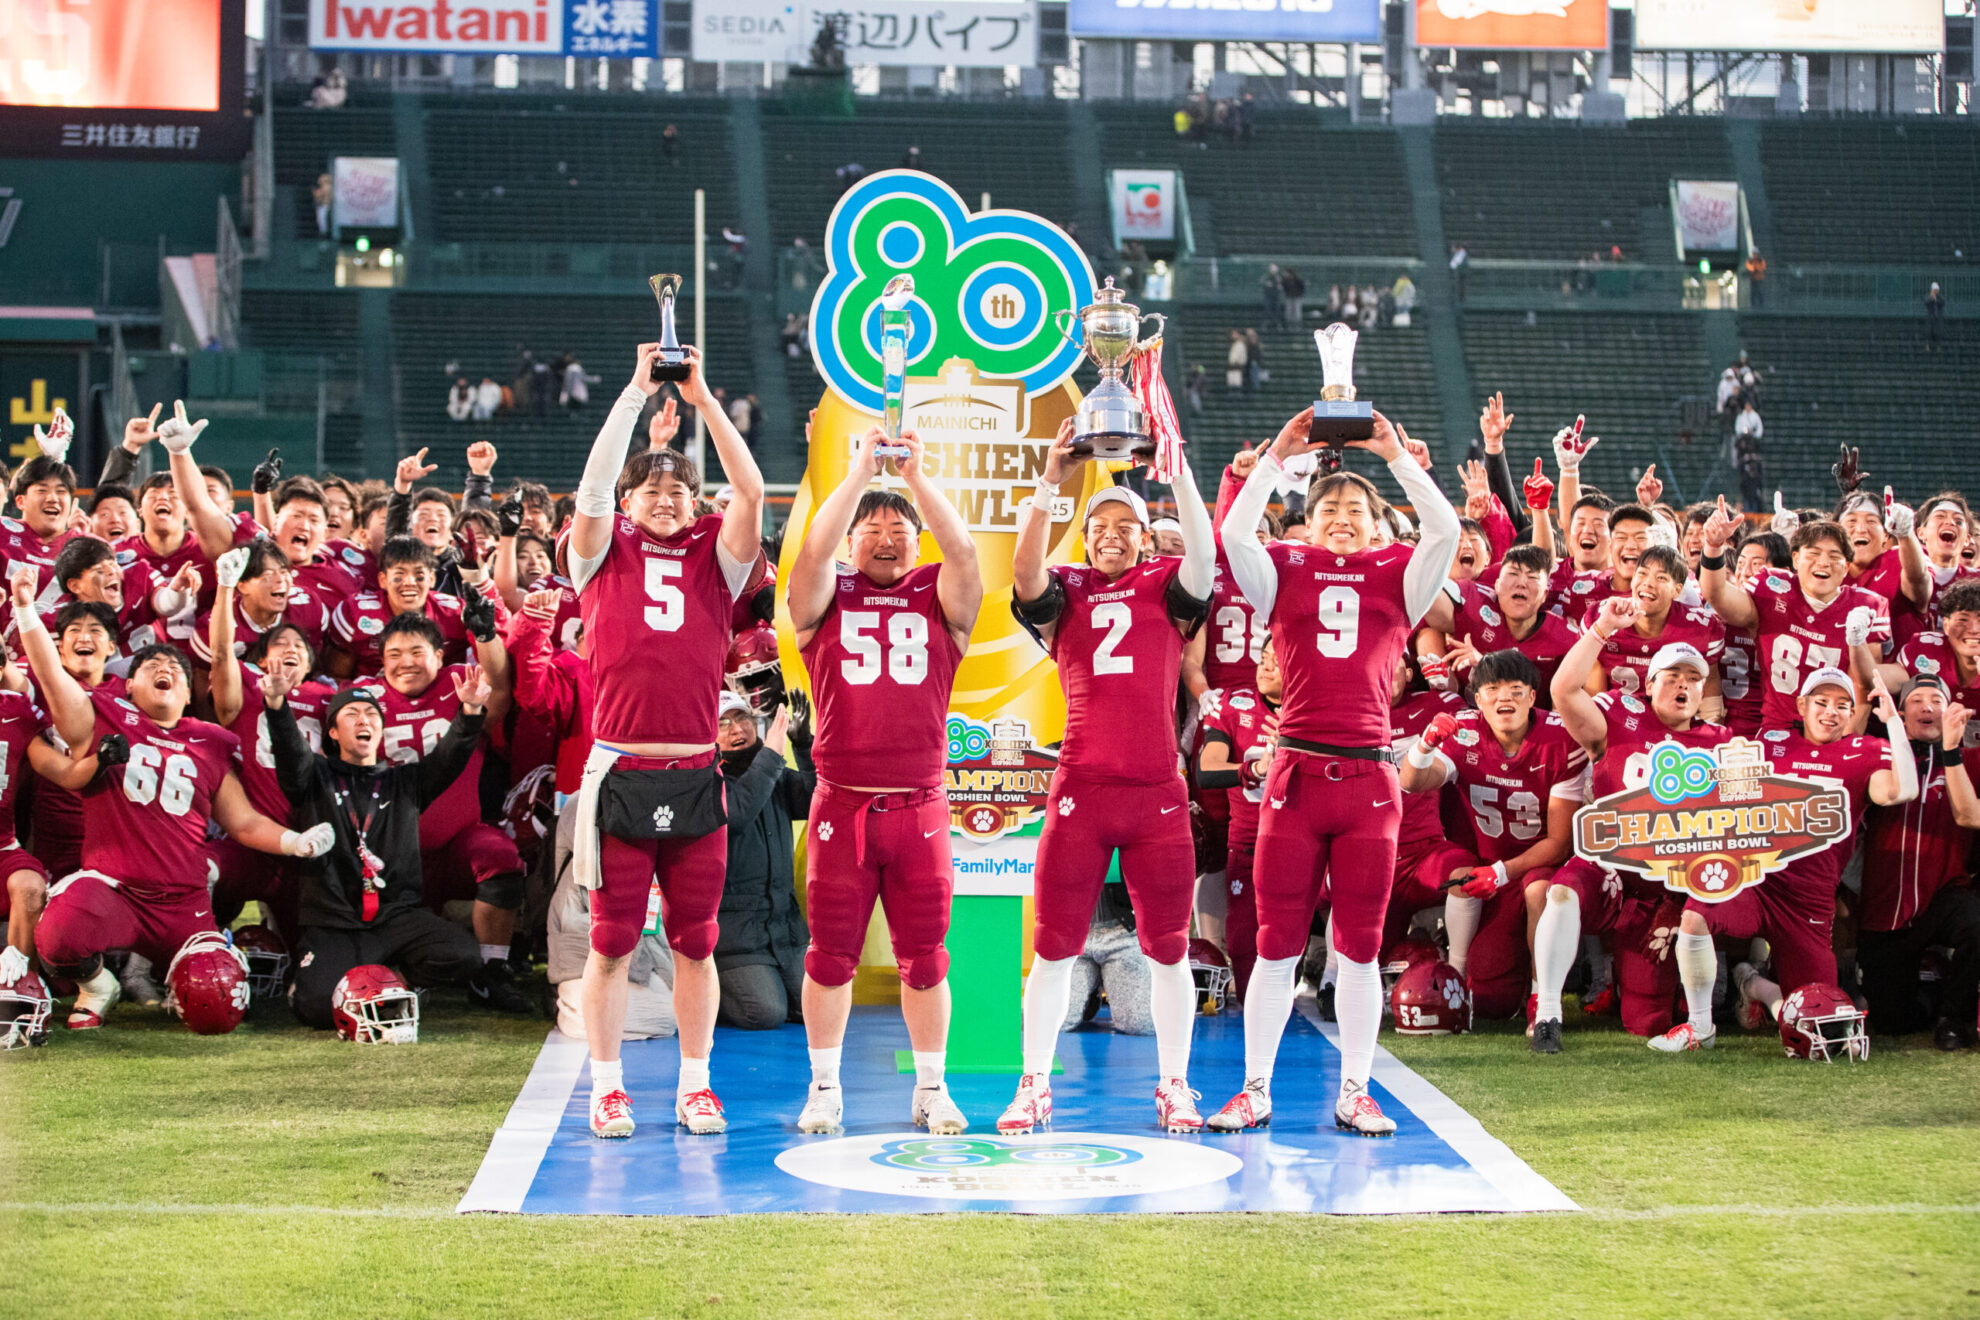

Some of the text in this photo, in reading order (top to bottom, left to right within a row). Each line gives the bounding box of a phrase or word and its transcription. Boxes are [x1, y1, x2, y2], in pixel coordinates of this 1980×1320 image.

[324, 0, 547, 42] Iwatani
[572, 0, 648, 34] 水素
[703, 16, 785, 34] SEDIA
[572, 36, 648, 50] エネルギー
[61, 124, 199, 149] 三井住友銀行
[991, 294, 1015, 319] th
[917, 415, 997, 431] MAINICHI
[856, 440, 1051, 481] SHIEN
[641, 541, 687, 556] RITSUMEIKAN
[1314, 571, 1365, 582] RITSUMEIKAN
[644, 557, 685, 632] 5
[863, 596, 908, 608] RITSUMEIKAN
[1087, 588, 1136, 603] RITSUMEIKAN
[1317, 586, 1360, 659] 9
[1091, 602, 1134, 676] 2
[1790, 624, 1826, 642] RITSUMEIKAN
[840, 610, 929, 685] 58
[1771, 634, 1841, 695] 87
[985, 740, 1031, 749] KOSHIEN
[992, 751, 1024, 760] BOWL
[1649, 745, 1718, 805] 80
[1709, 765, 1770, 780] KOSHIEN
[1792, 761, 1832, 772] RITSUMEIKAN
[123, 743, 198, 817] 66
[944, 770, 1054, 794] AMPION
[1486, 774, 1523, 787] RITSUMEIKAN
[1720, 782, 1761, 794] BOWL
[948, 793, 1027, 802] OSHIEN BOWL
[1470, 784, 1541, 839] 53
[1581, 794, 1844, 853] CHAMPIONS
[1655, 836, 1772, 855] KOSHIEN BOWL
[953, 858, 1035, 875] FamilyMar
[1400, 1005, 1421, 1026] 53
